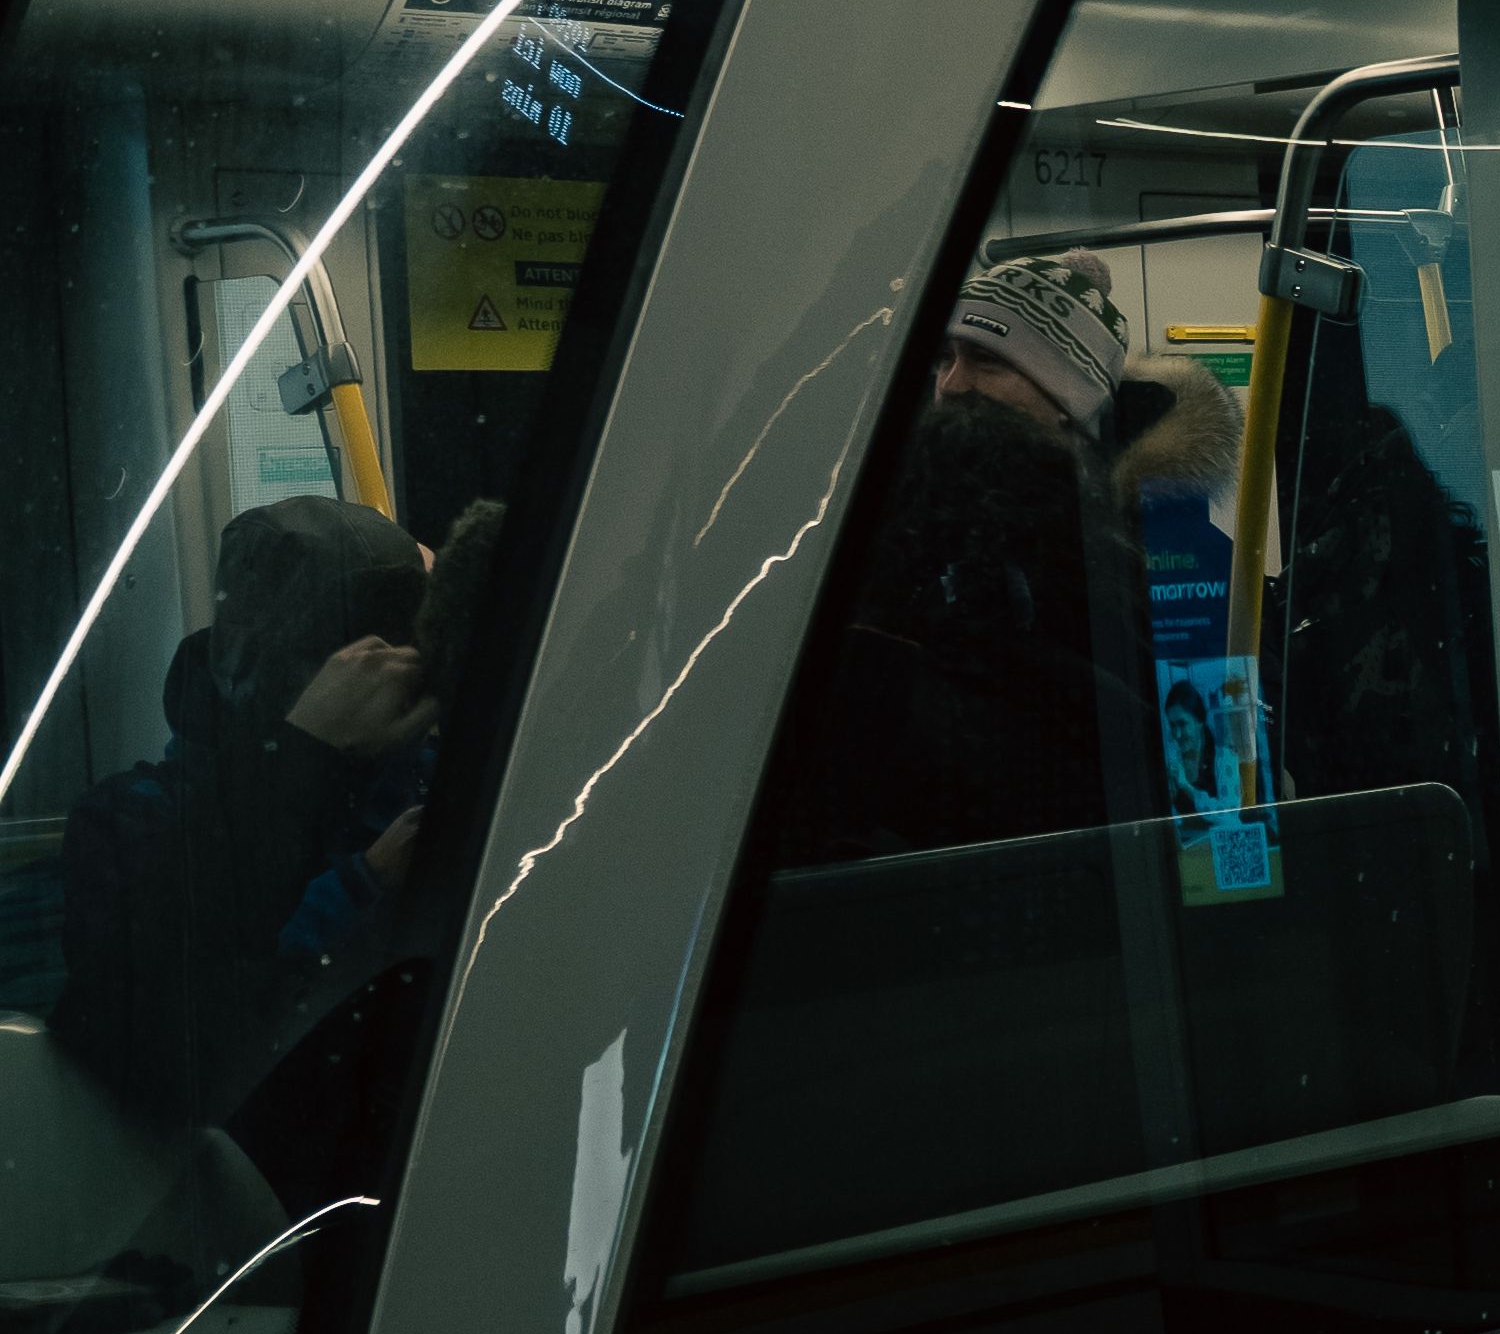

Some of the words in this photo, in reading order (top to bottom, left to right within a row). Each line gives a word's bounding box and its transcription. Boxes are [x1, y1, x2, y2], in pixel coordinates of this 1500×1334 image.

[1035, 149, 1107, 187] 6217
[511, 228, 532, 242] Ne
[537, 230, 564, 245] pas
